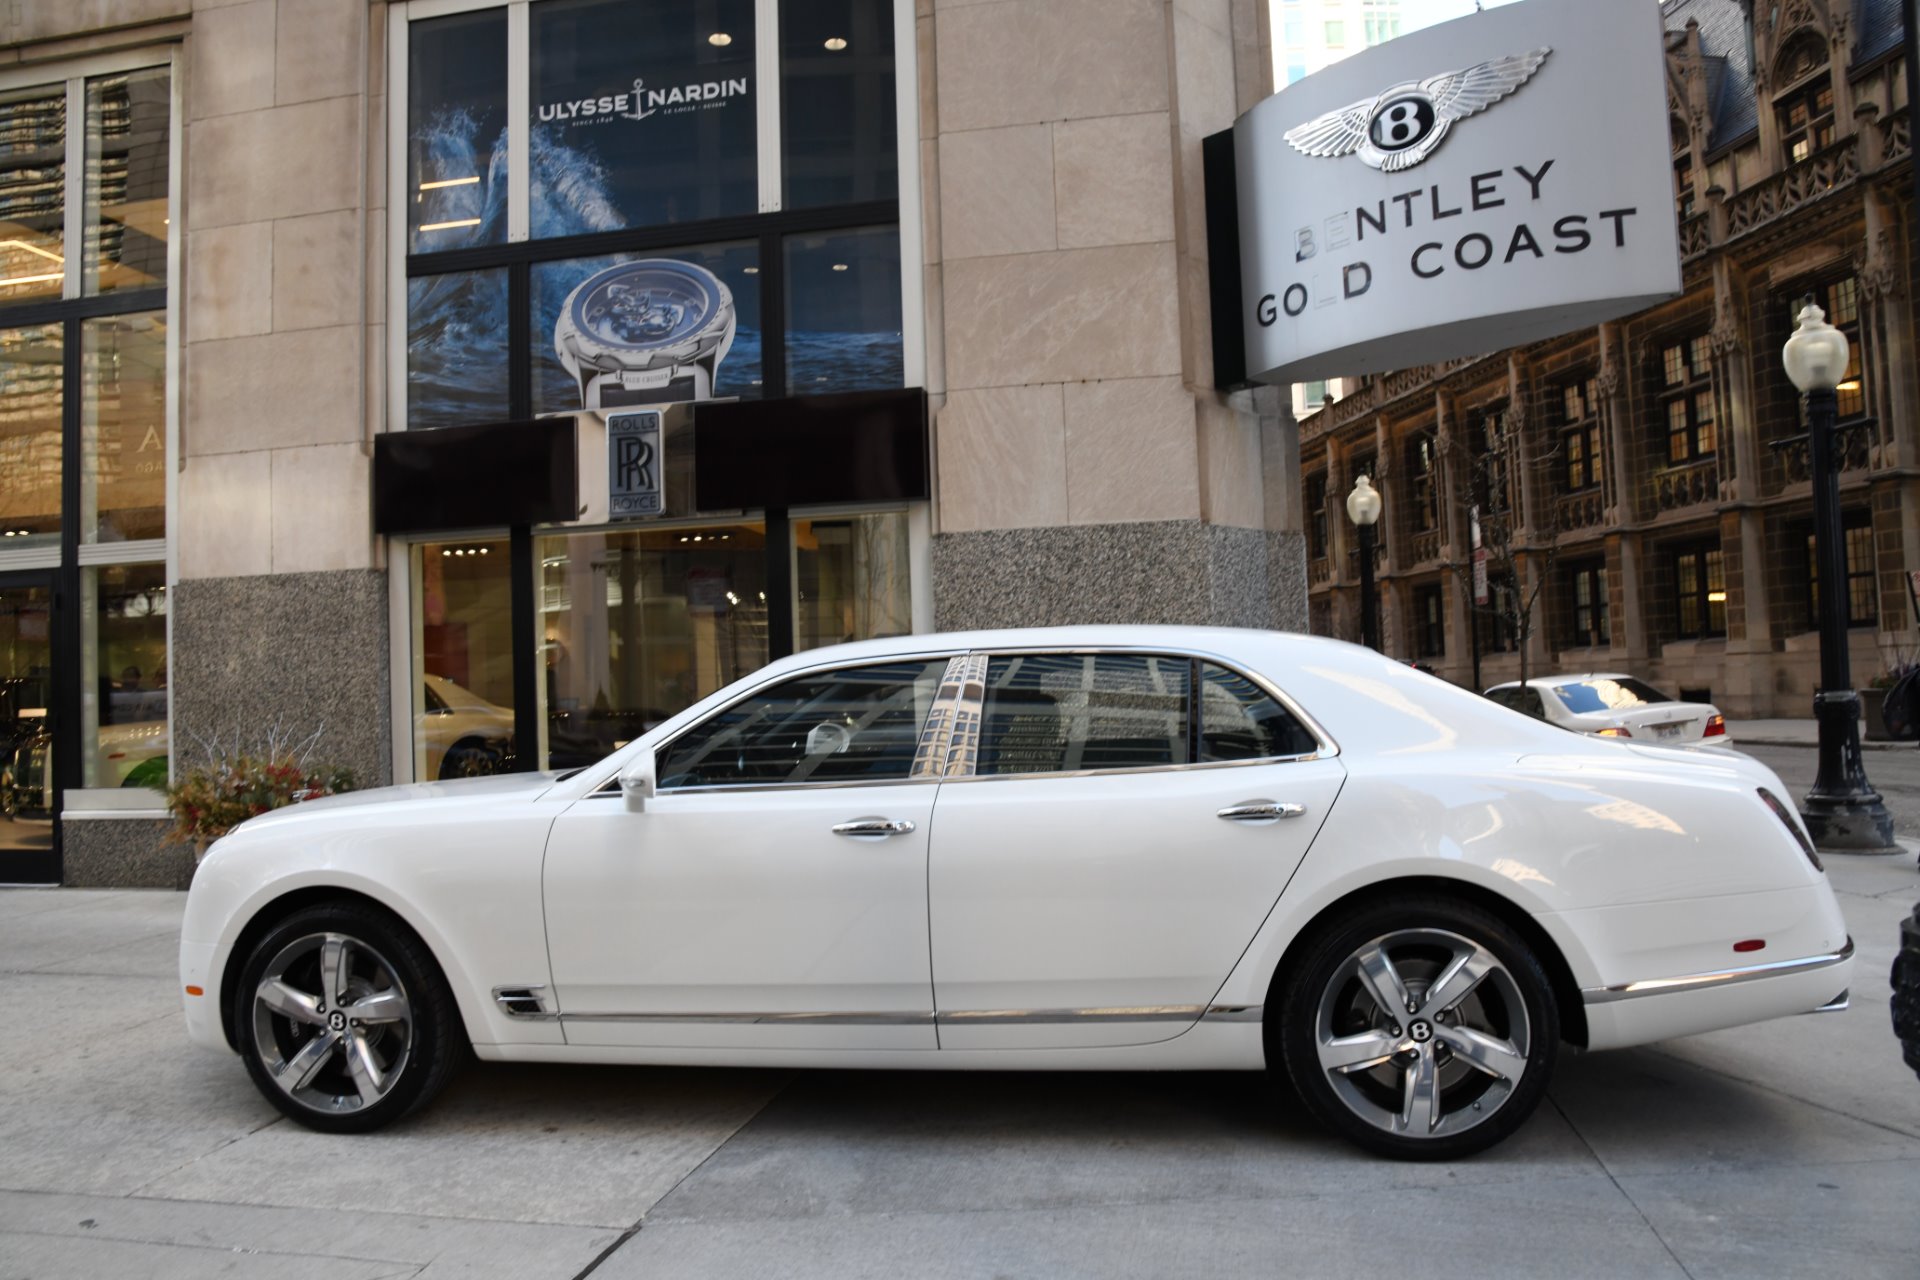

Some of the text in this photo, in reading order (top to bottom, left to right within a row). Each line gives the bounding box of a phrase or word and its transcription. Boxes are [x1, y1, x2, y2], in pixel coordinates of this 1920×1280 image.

[539, 77, 747, 121] ULYSSE NARDIN
[1411, 207, 1637, 280] COAST
[612, 416, 656, 431] ROLLS
[613, 495, 657, 510] ROYCE
